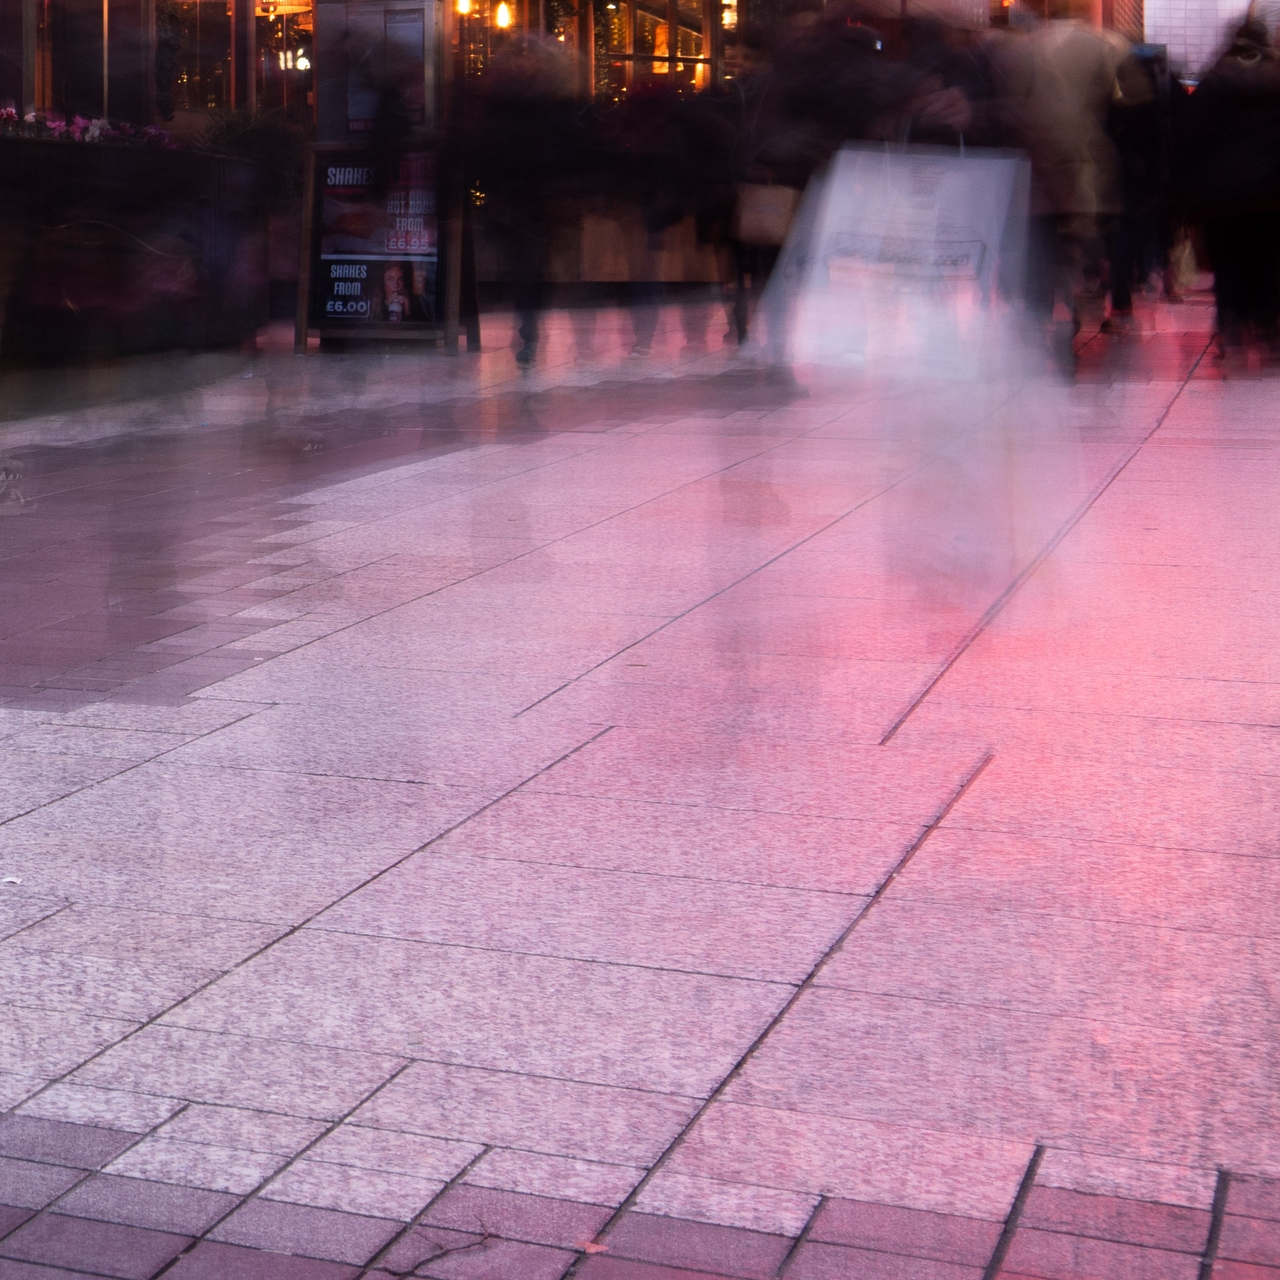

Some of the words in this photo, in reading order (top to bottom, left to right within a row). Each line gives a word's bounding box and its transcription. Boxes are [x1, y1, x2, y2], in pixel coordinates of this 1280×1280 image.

[396, 218, 424, 231] FROM
[330, 265, 368, 278] SHAKES
[334, 282, 361, 295] FROM
[326, 301, 367, 312] £6.00
